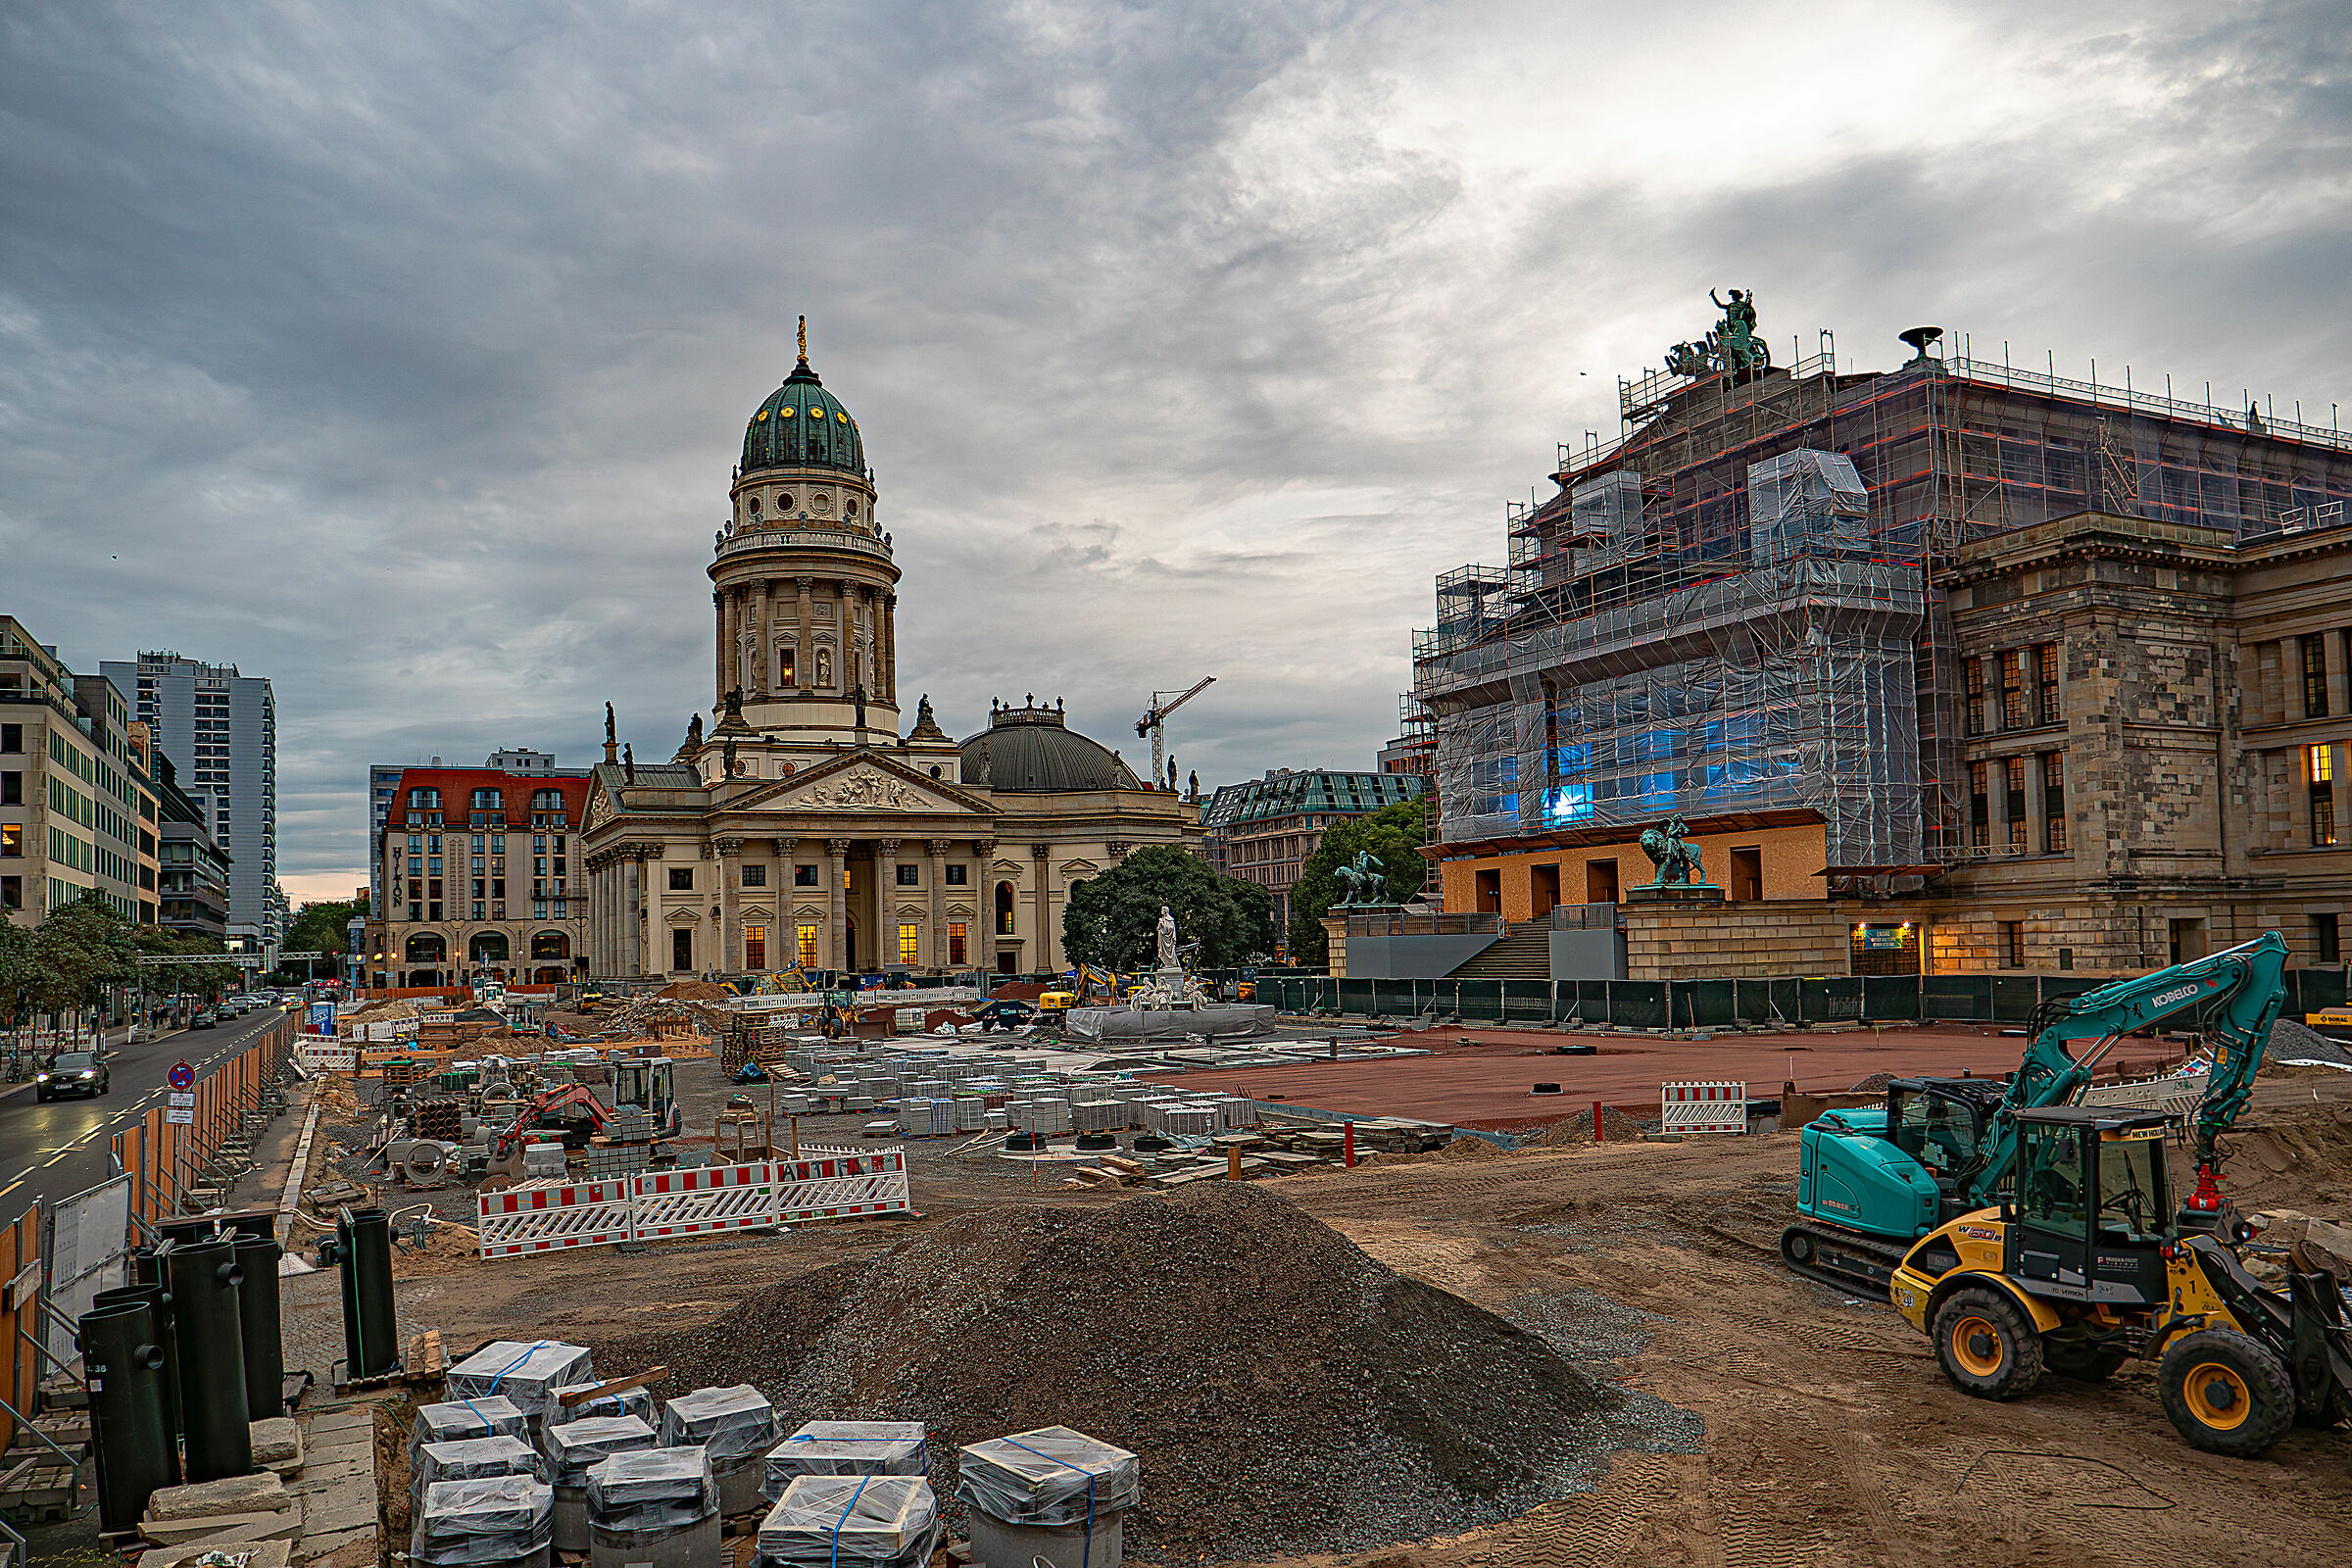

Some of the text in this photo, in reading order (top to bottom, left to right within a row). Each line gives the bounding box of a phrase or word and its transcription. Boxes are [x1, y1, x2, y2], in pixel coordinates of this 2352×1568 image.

[393, 847, 403, 907] HILTON
[2151, 984, 2198, 1008] KOBELCO
[781, 1158, 865, 1181] ANTIFA
[2189, 1280, 2196, 1295] 1
